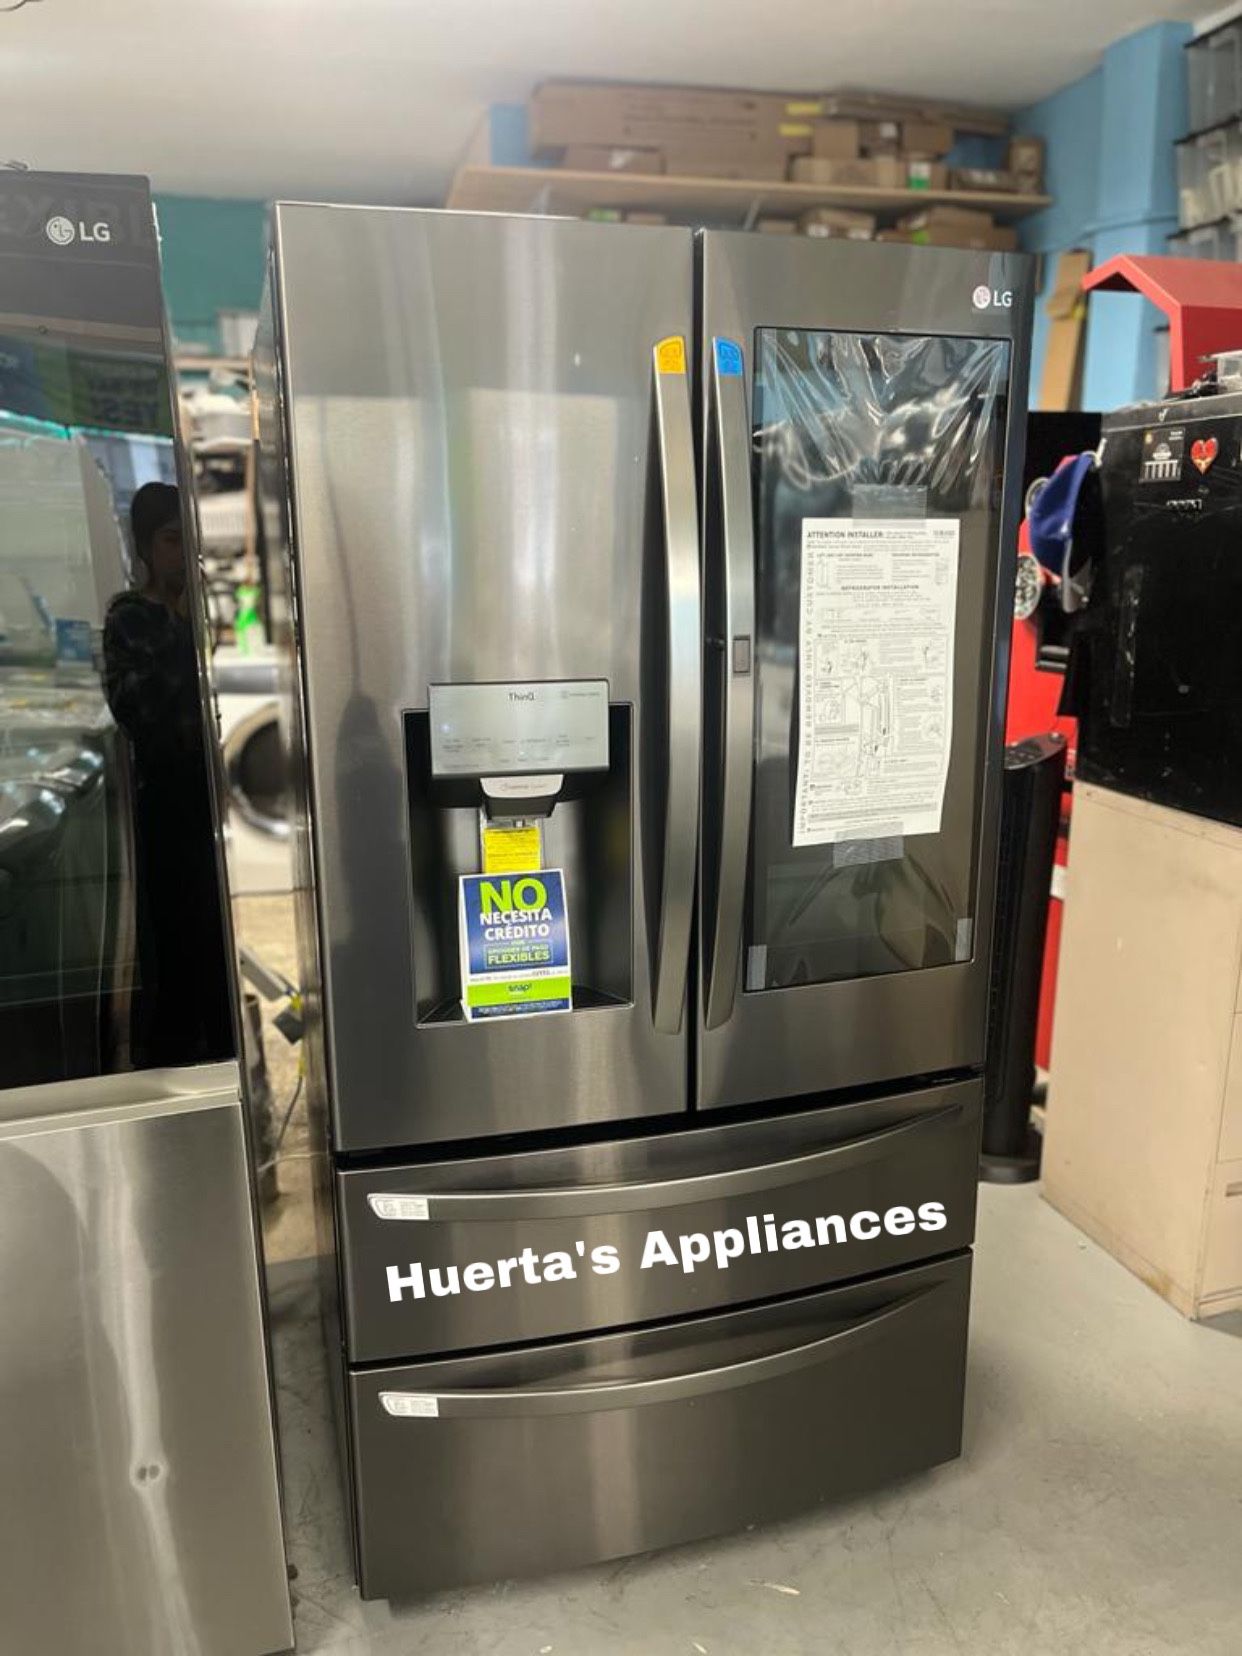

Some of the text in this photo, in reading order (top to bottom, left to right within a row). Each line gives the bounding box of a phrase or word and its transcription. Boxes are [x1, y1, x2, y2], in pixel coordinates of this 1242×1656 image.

[807, 530, 845, 539] ATTENTION
[509, 692, 535, 702] ThinQ
[480, 879, 548, 912] NO
[480, 907, 553, 926] NECESITA
[488, 950, 550, 965] FLEXIBLES
